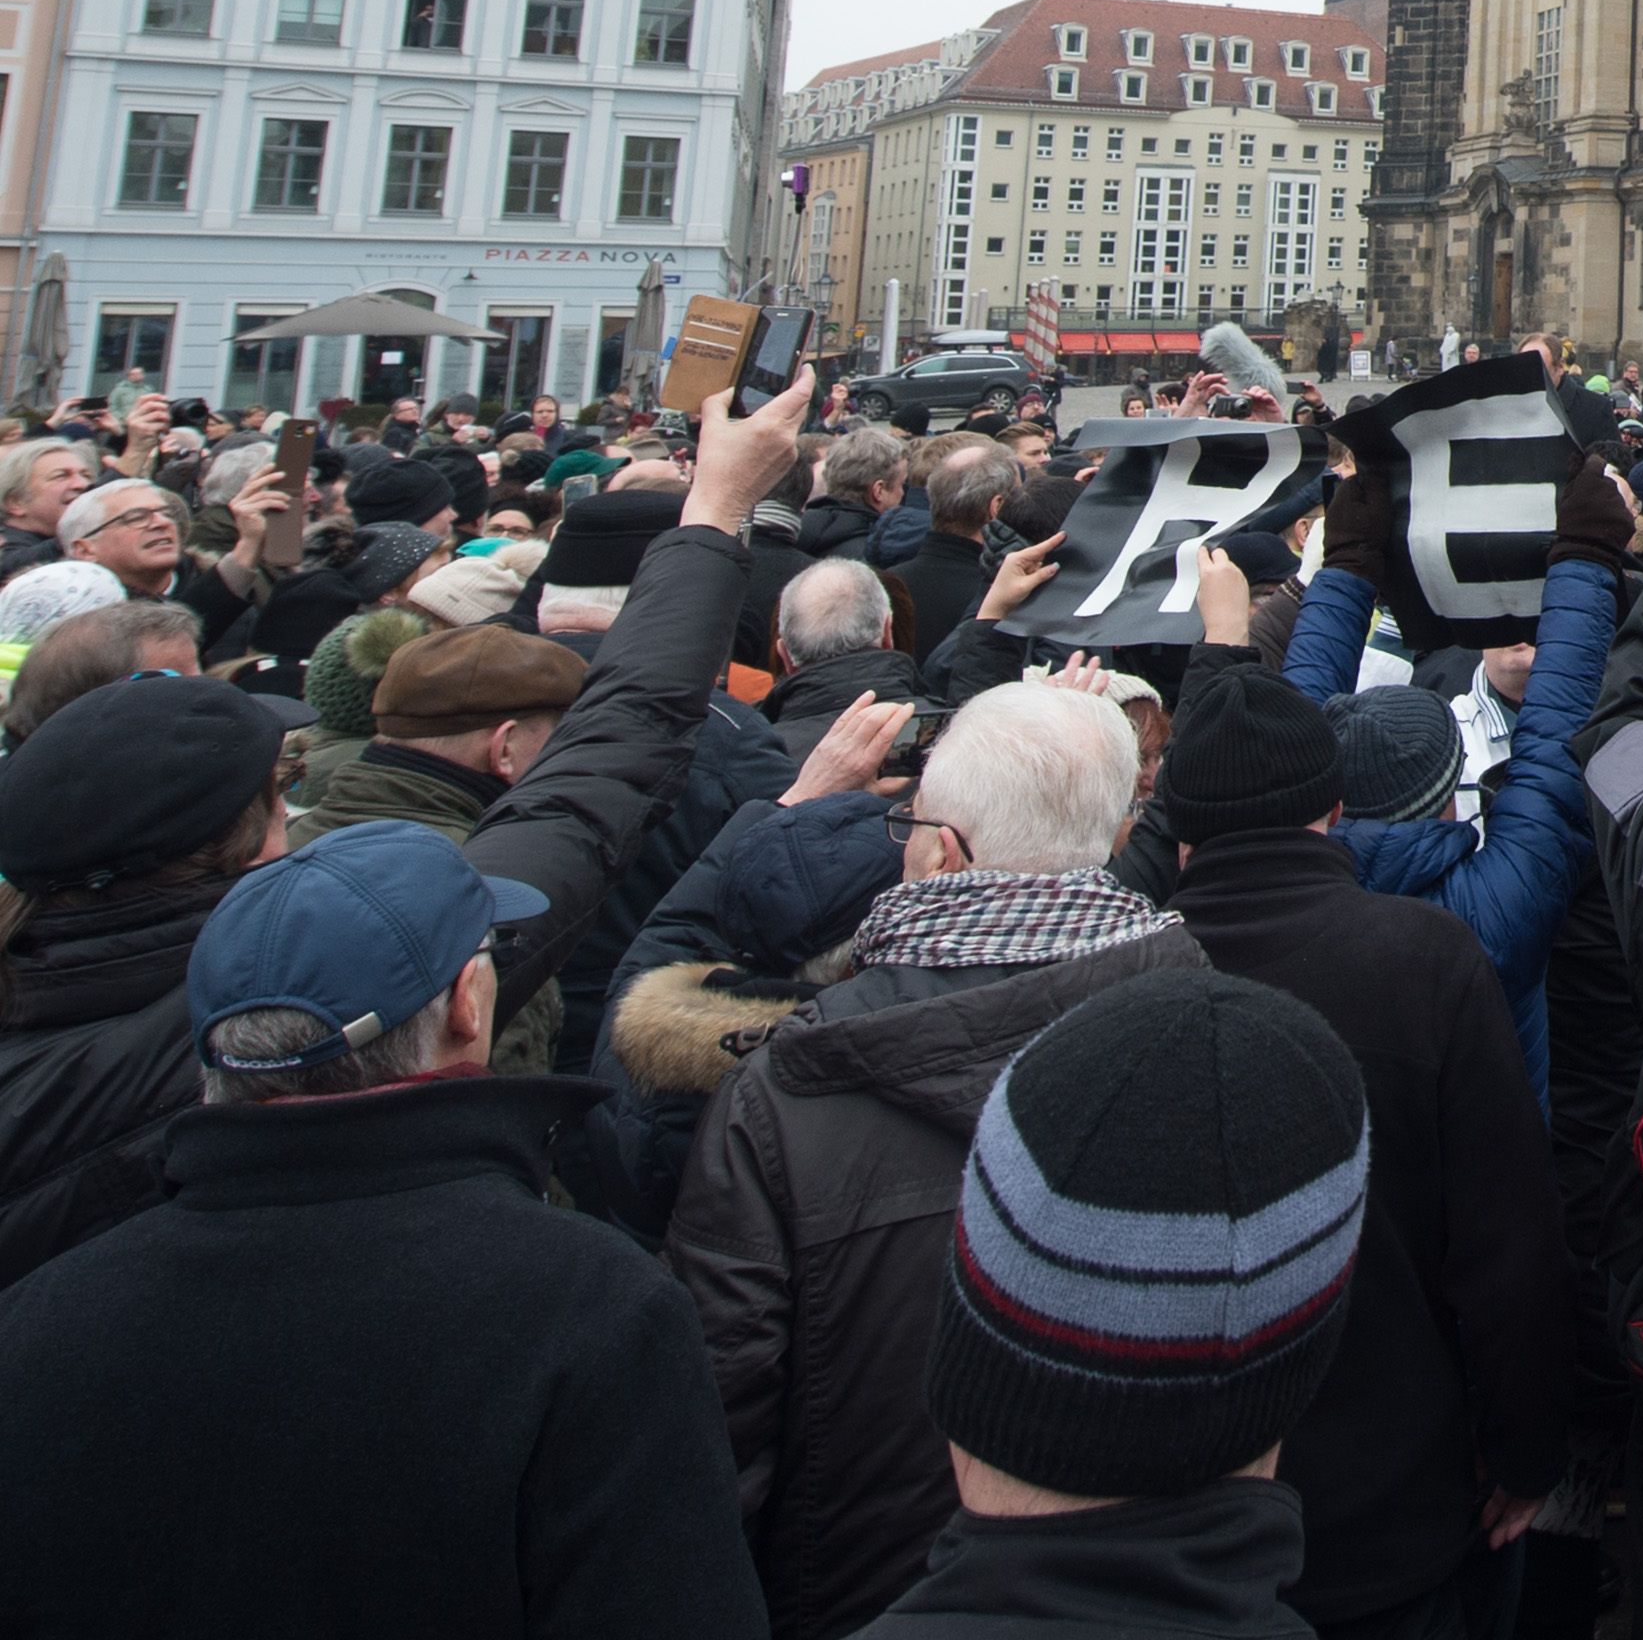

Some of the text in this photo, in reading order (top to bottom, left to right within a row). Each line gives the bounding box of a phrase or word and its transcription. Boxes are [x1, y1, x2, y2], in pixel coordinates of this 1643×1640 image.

[484, 248, 678, 265] PIAZZA NOVA
[1391, 391, 1566, 621] E
